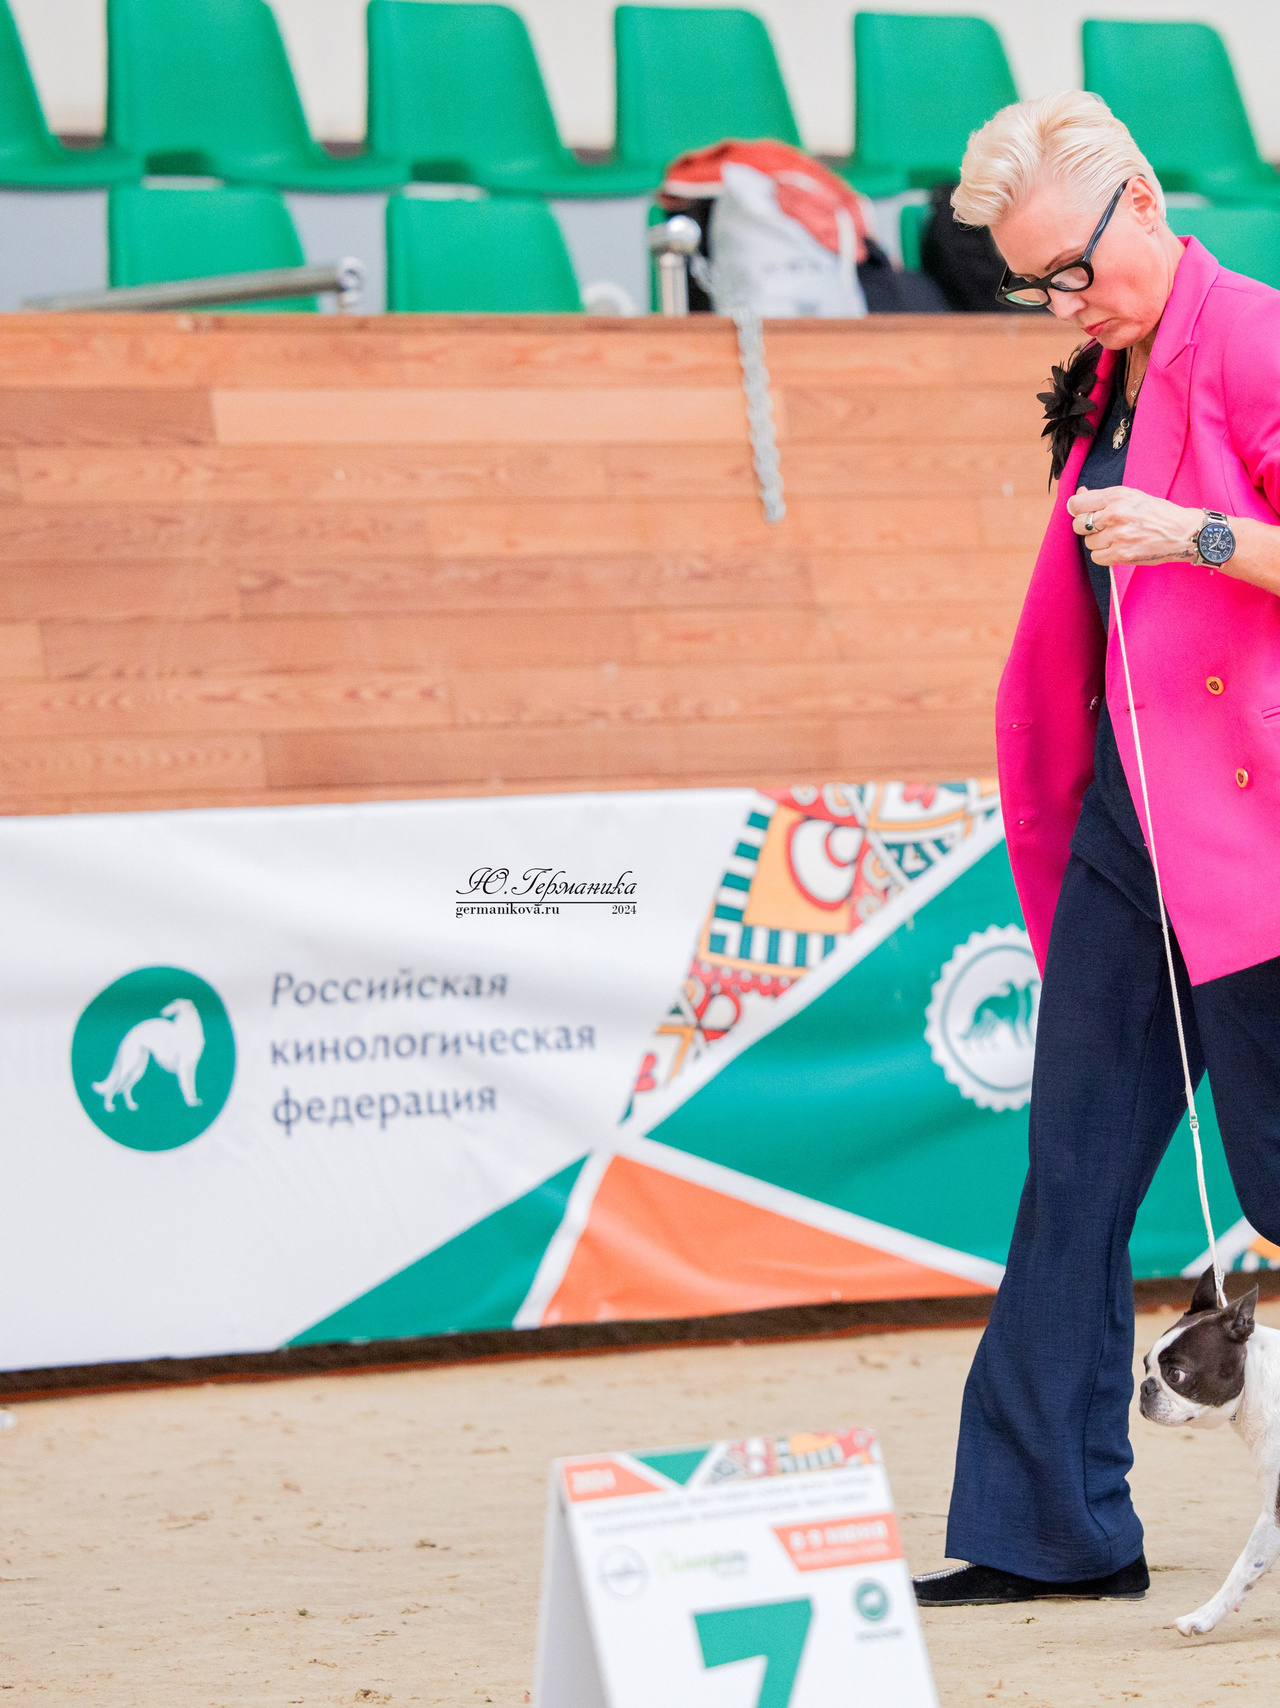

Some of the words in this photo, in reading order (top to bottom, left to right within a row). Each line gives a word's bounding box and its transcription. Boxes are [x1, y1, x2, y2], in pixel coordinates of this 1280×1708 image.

[272, 968, 508, 1007] Российская
[271, 1024, 596, 1066] кинологическая
[272, 1086, 498, 1137] федерация
